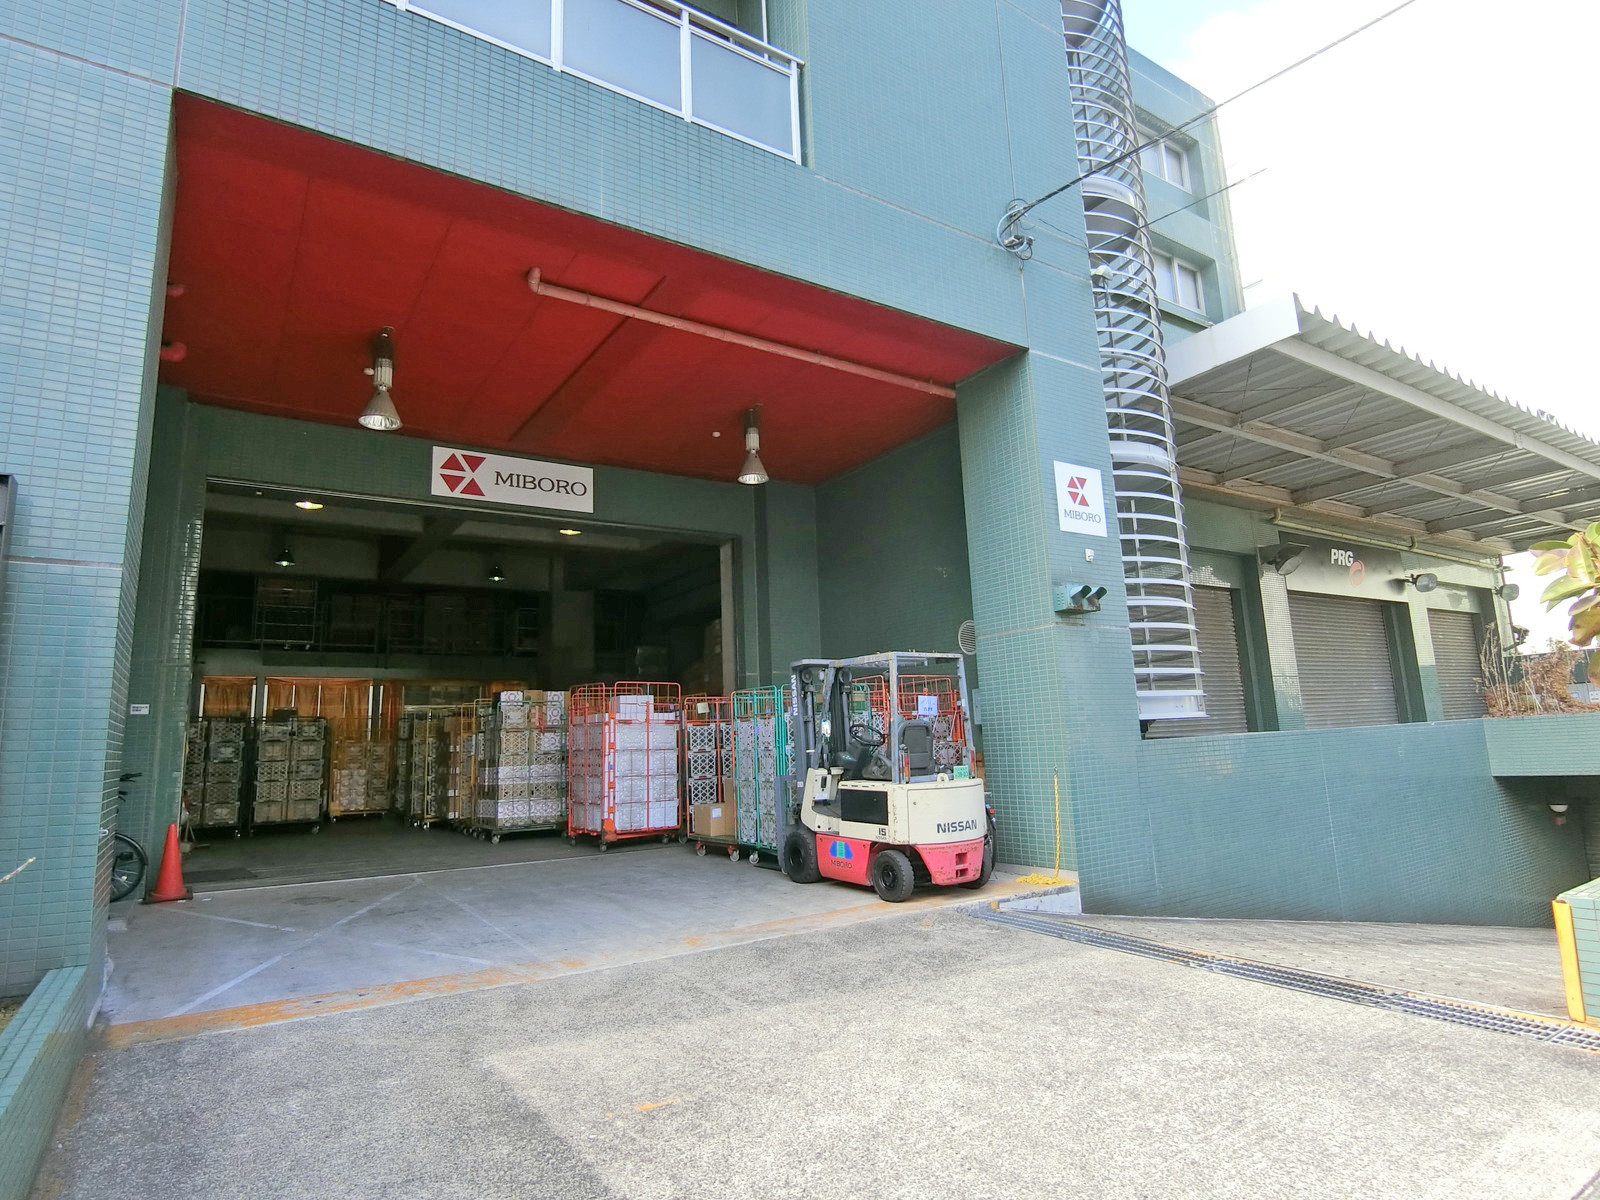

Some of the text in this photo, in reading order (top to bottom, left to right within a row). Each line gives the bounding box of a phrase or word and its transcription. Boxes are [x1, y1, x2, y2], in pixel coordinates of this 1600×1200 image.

[494, 471, 587, 496] MIBORO
[1064, 509, 1101, 523] MIBORO
[1331, 549, 1353, 566] PRG
[878, 827, 887, 836] 15
[937, 819, 977, 834] NISSAN
